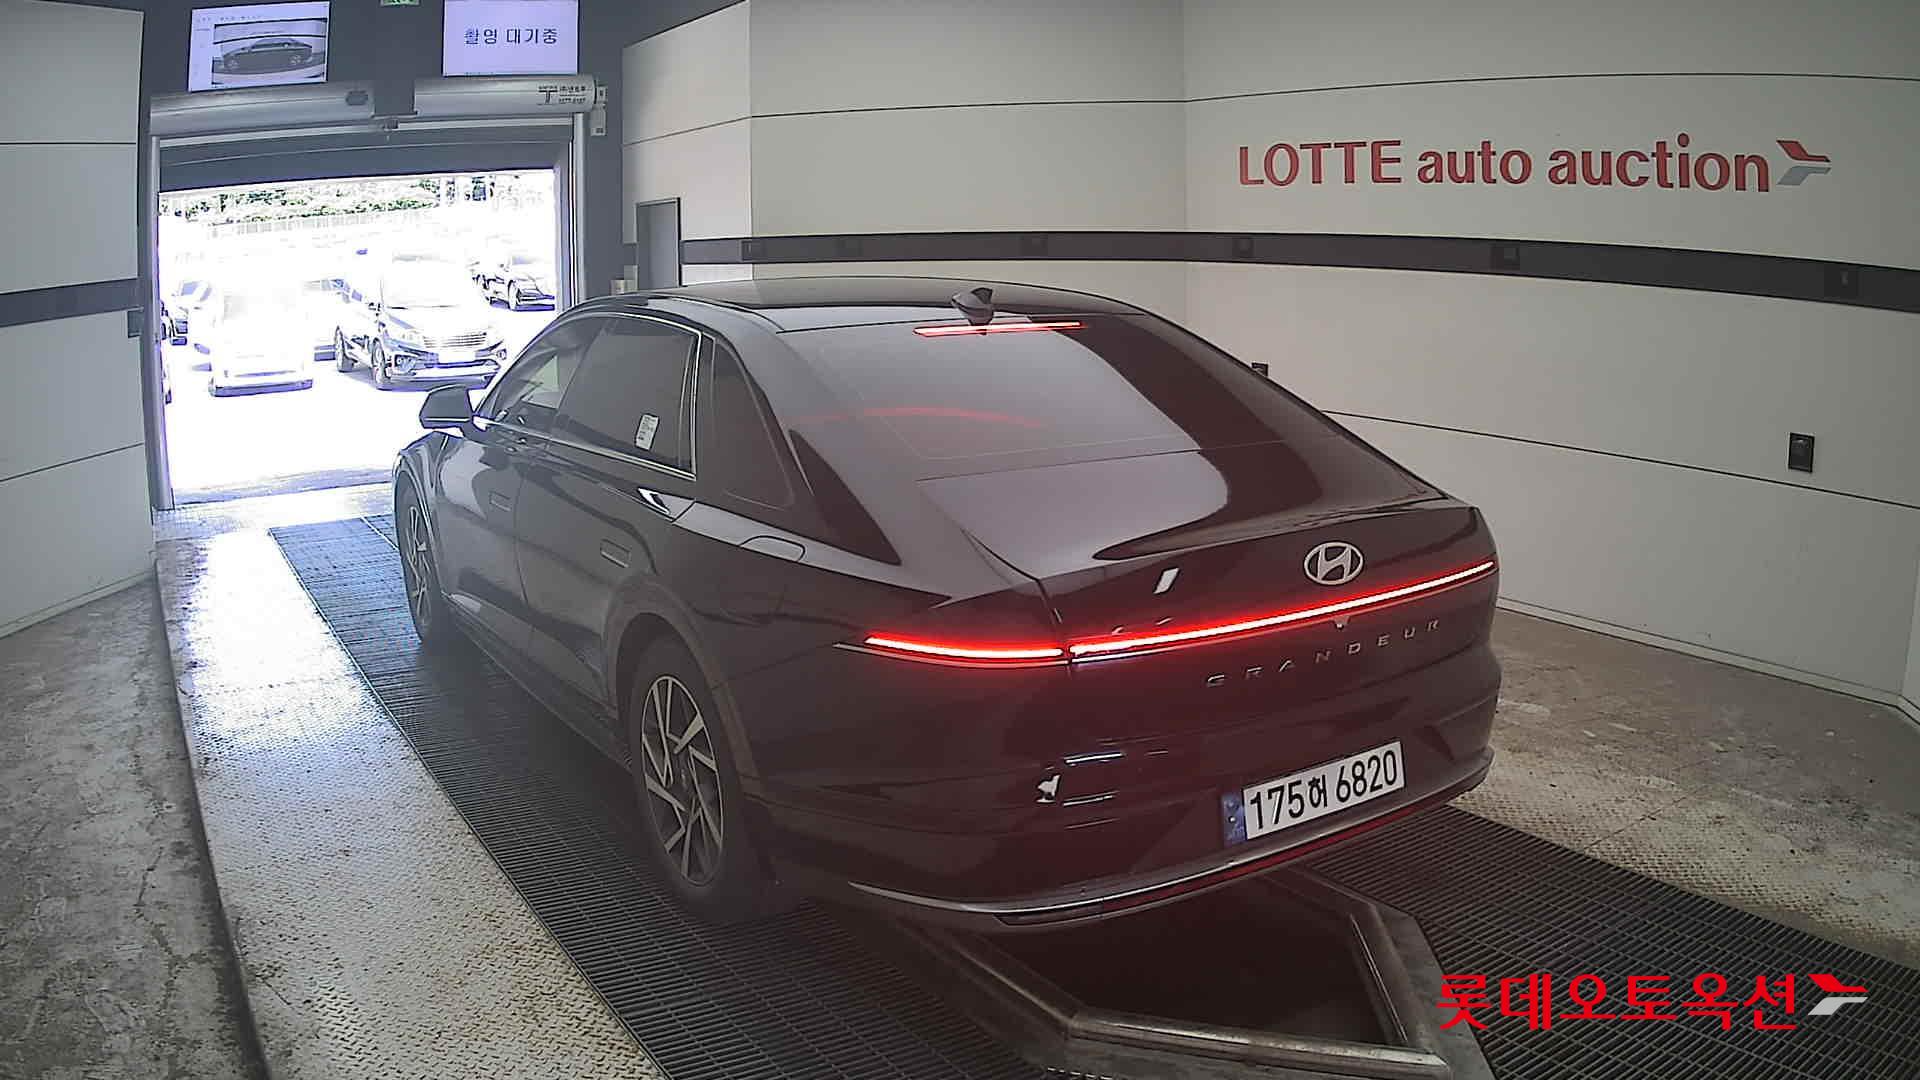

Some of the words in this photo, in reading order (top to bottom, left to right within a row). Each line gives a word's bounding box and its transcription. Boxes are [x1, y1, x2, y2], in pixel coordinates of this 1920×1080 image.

[506, 28, 558, 45] 대기중
[1239, 140, 1401, 186] LOTTE
[1416, 141, 1532, 185] auto
[1547, 133, 1770, 193] auction
[1206, 619, 1440, 687] GRANDEUR
